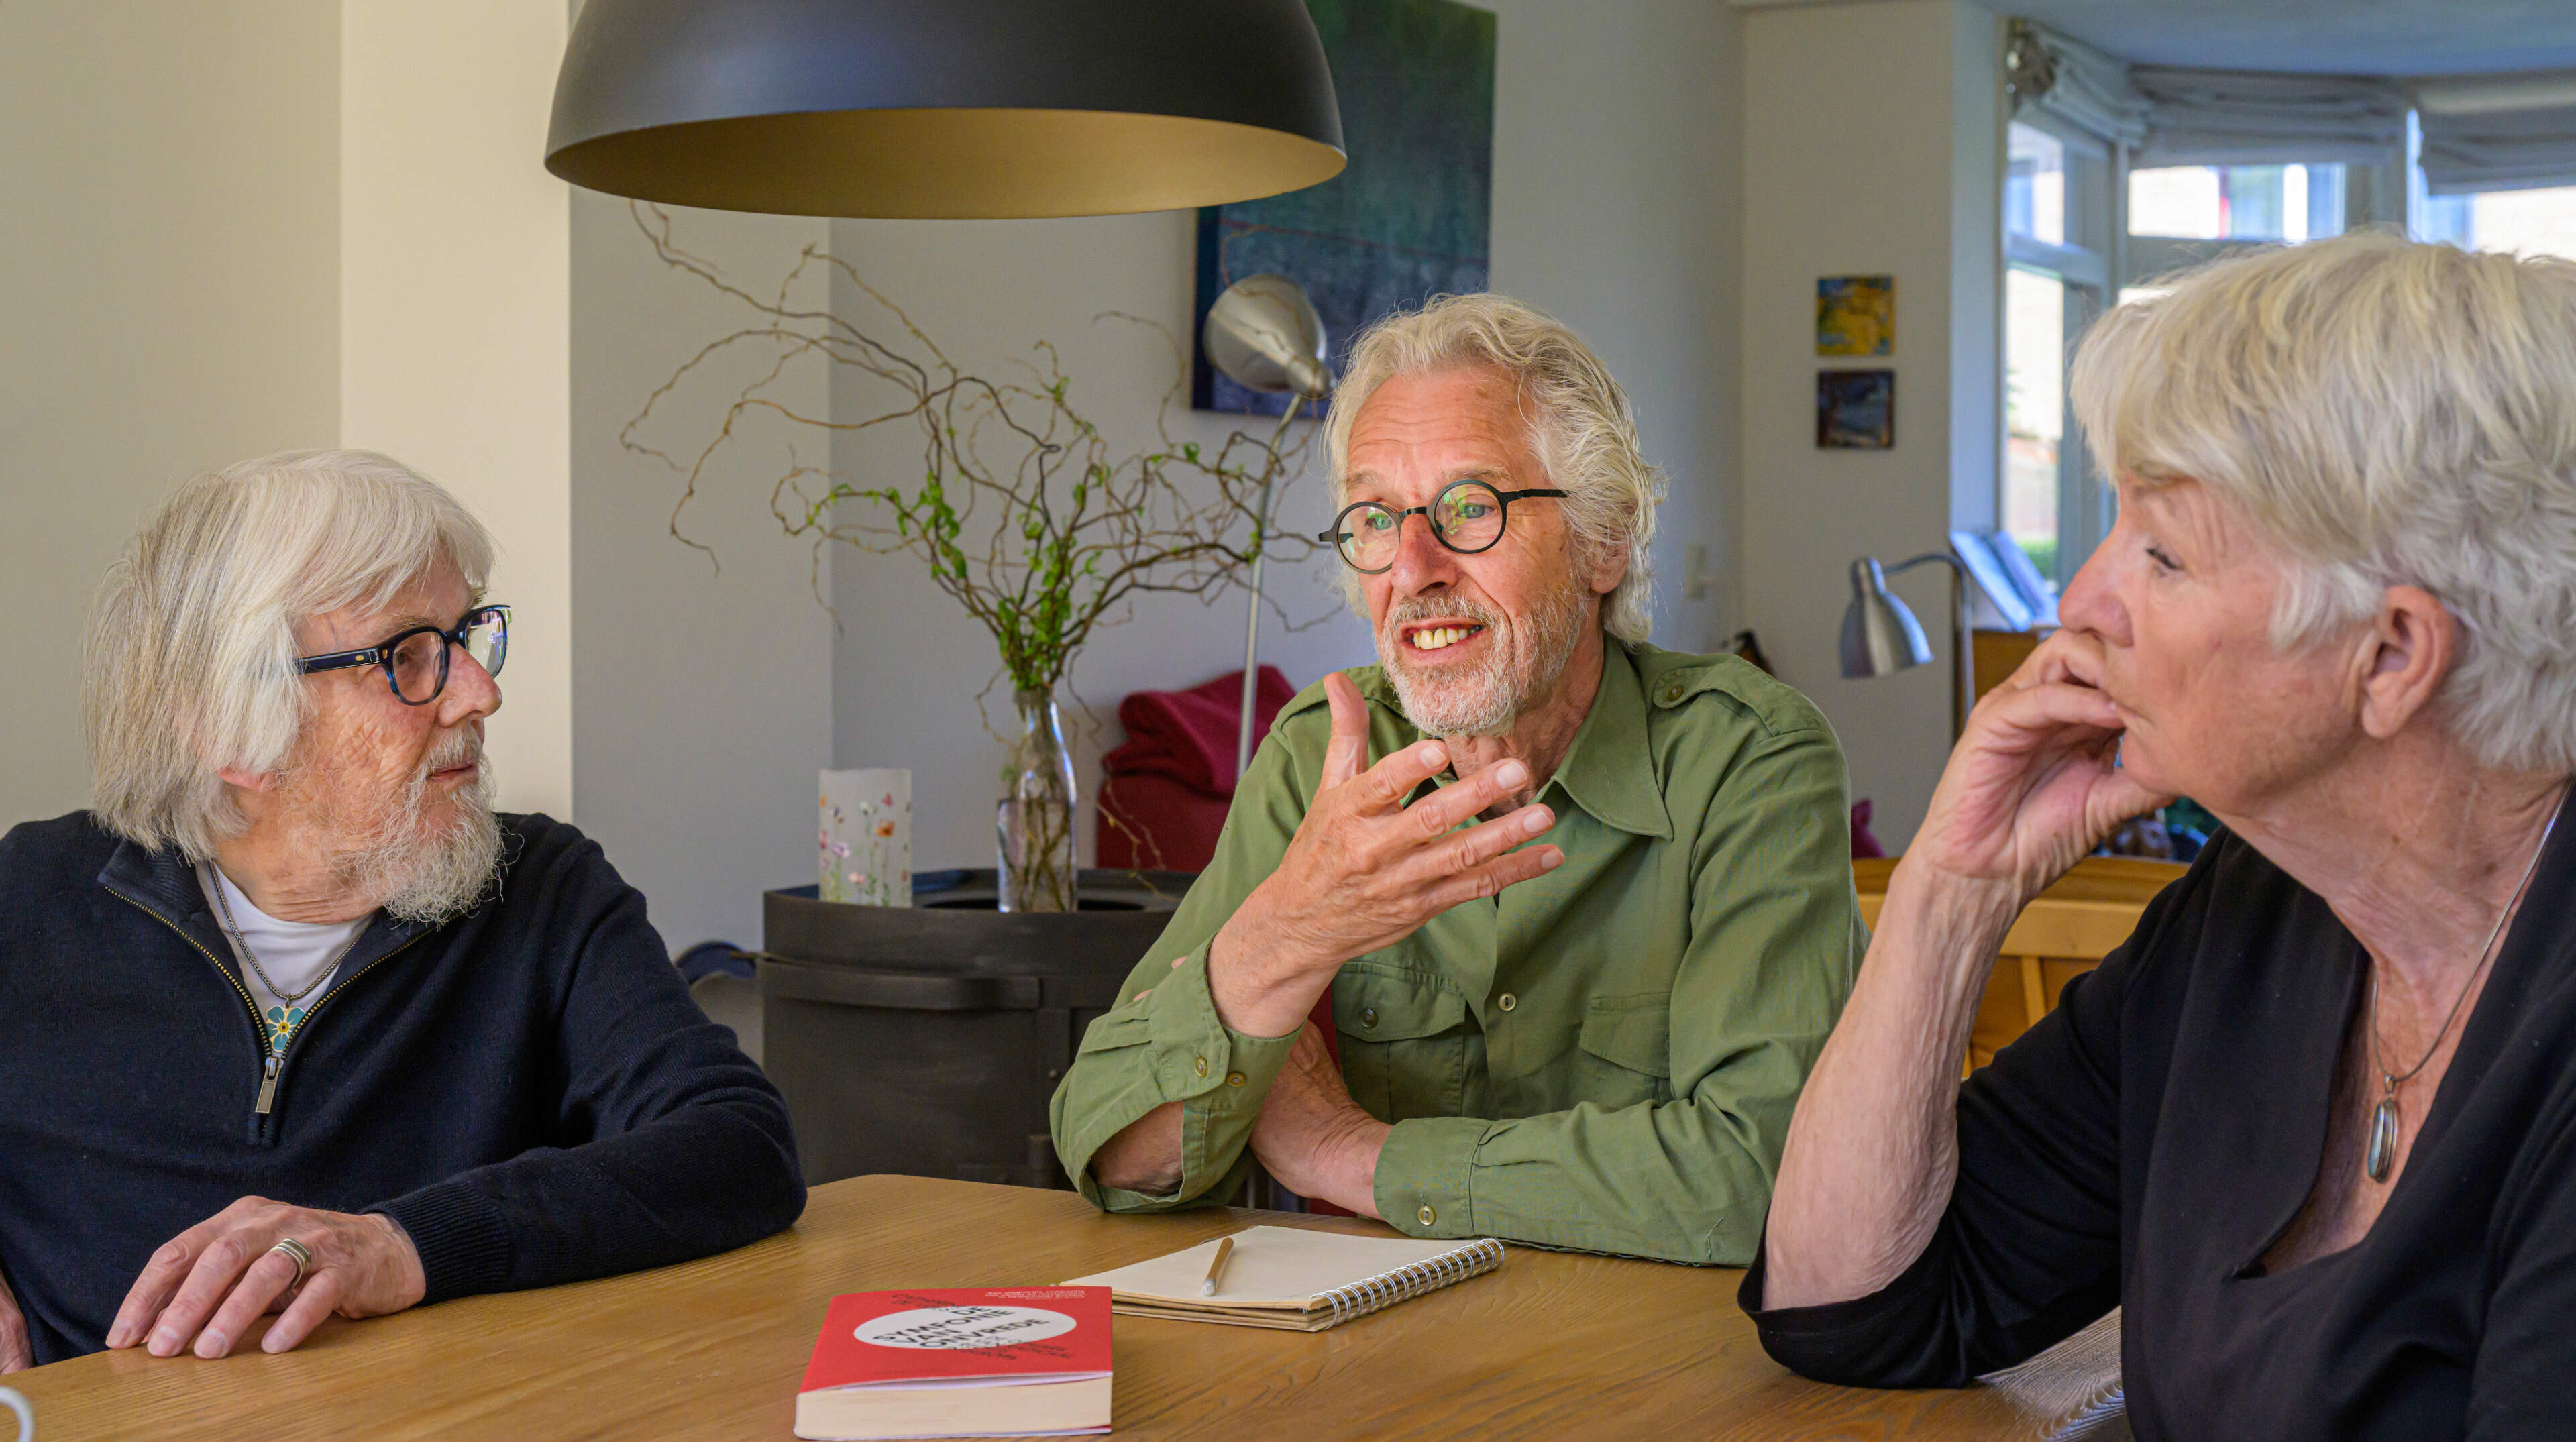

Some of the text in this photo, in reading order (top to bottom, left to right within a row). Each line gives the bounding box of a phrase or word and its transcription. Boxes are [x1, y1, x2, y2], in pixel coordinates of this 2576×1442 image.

[951, 1307, 991, 1315] DE
[873, 1310, 1015, 1341] SYMFONIE
[893, 1329, 962, 1343] VAN
[920, 1319, 1050, 1347] ONVREDE
